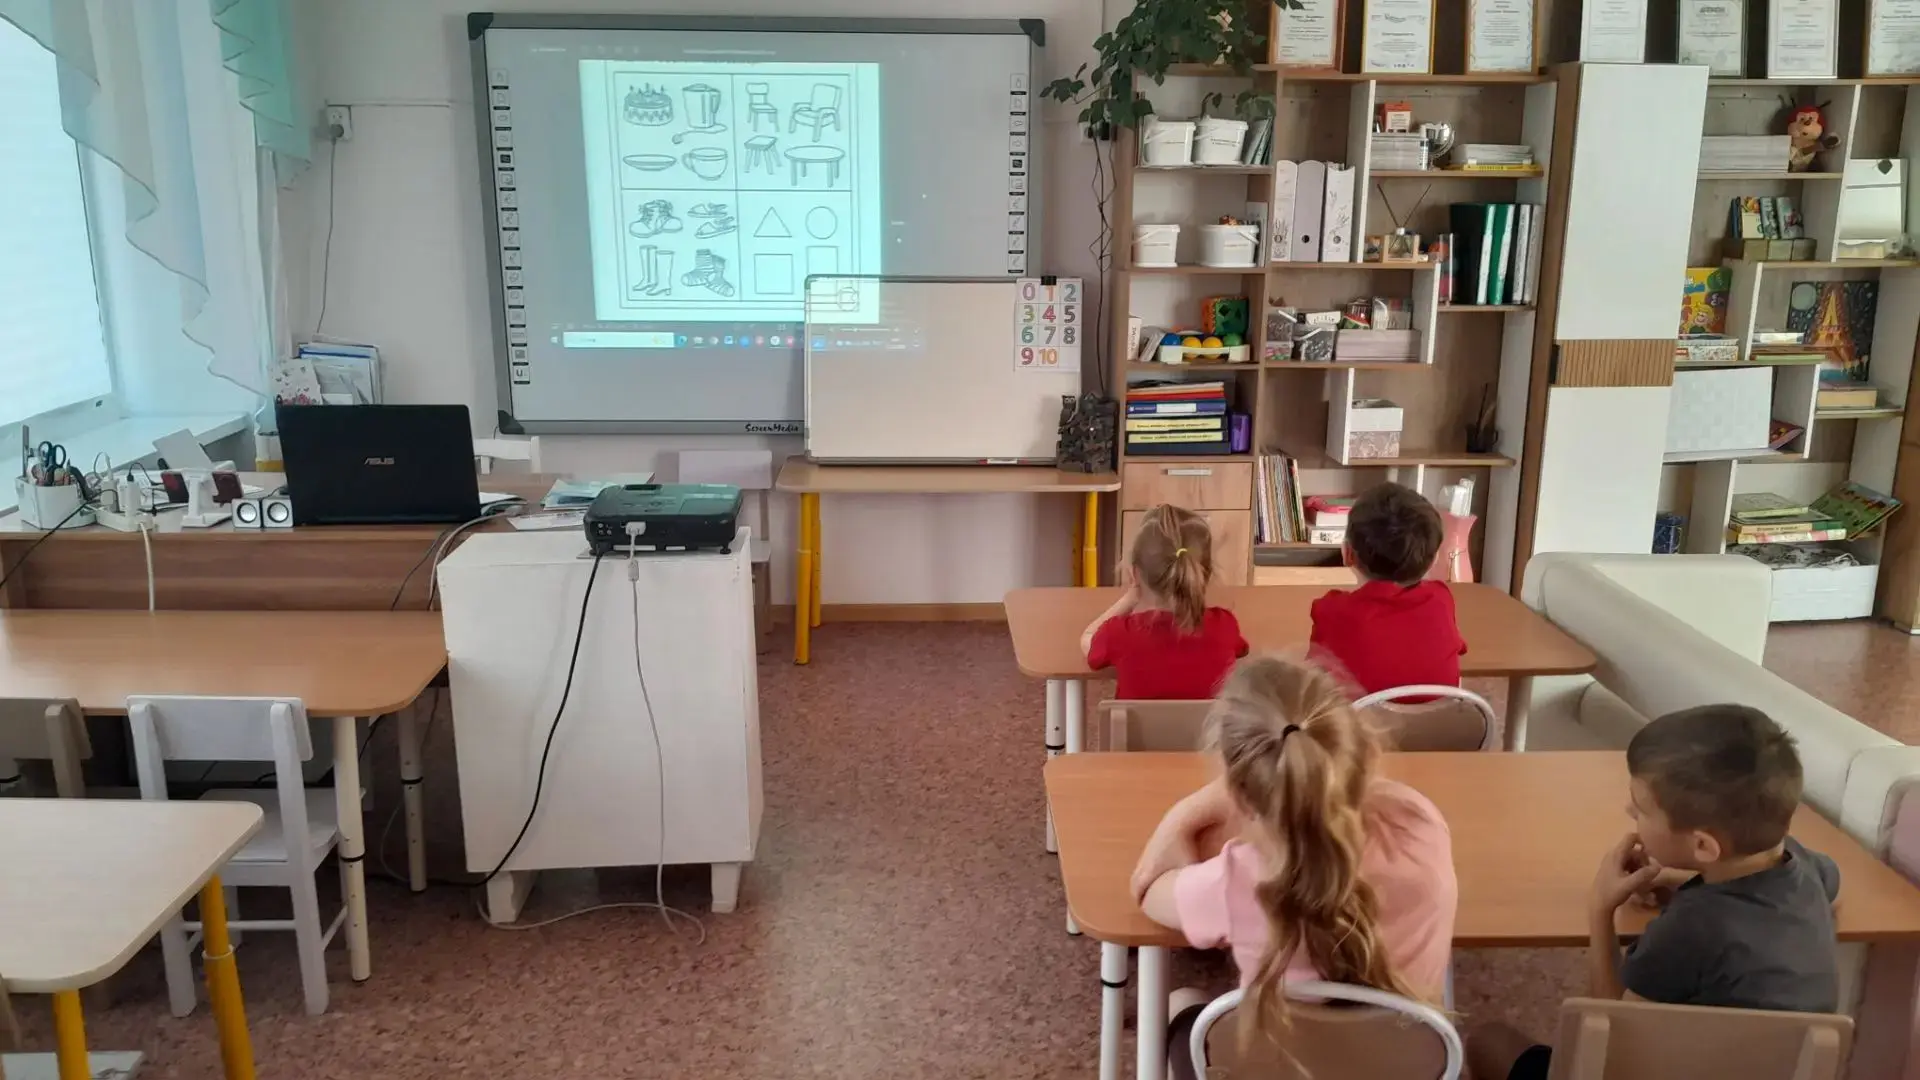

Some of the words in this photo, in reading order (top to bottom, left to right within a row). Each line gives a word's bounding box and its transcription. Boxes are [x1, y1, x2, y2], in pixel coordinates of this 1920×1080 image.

[1022, 283, 1036, 301] 0
[1045, 285, 1054, 302] 1
[1064, 283, 1077, 302] 2
[1023, 304, 1035, 323] 3
[1042, 305, 1056, 323] 4
[1064, 305, 1076, 323] 5
[1021, 326, 1034, 344] 6
[1044, 326, 1057, 344] 7
[1063, 326, 1076, 345] 8
[1021, 347, 1034, 365] 9
[1039, 348, 1058, 365] 10
[364, 457, 395, 465] ASUS
